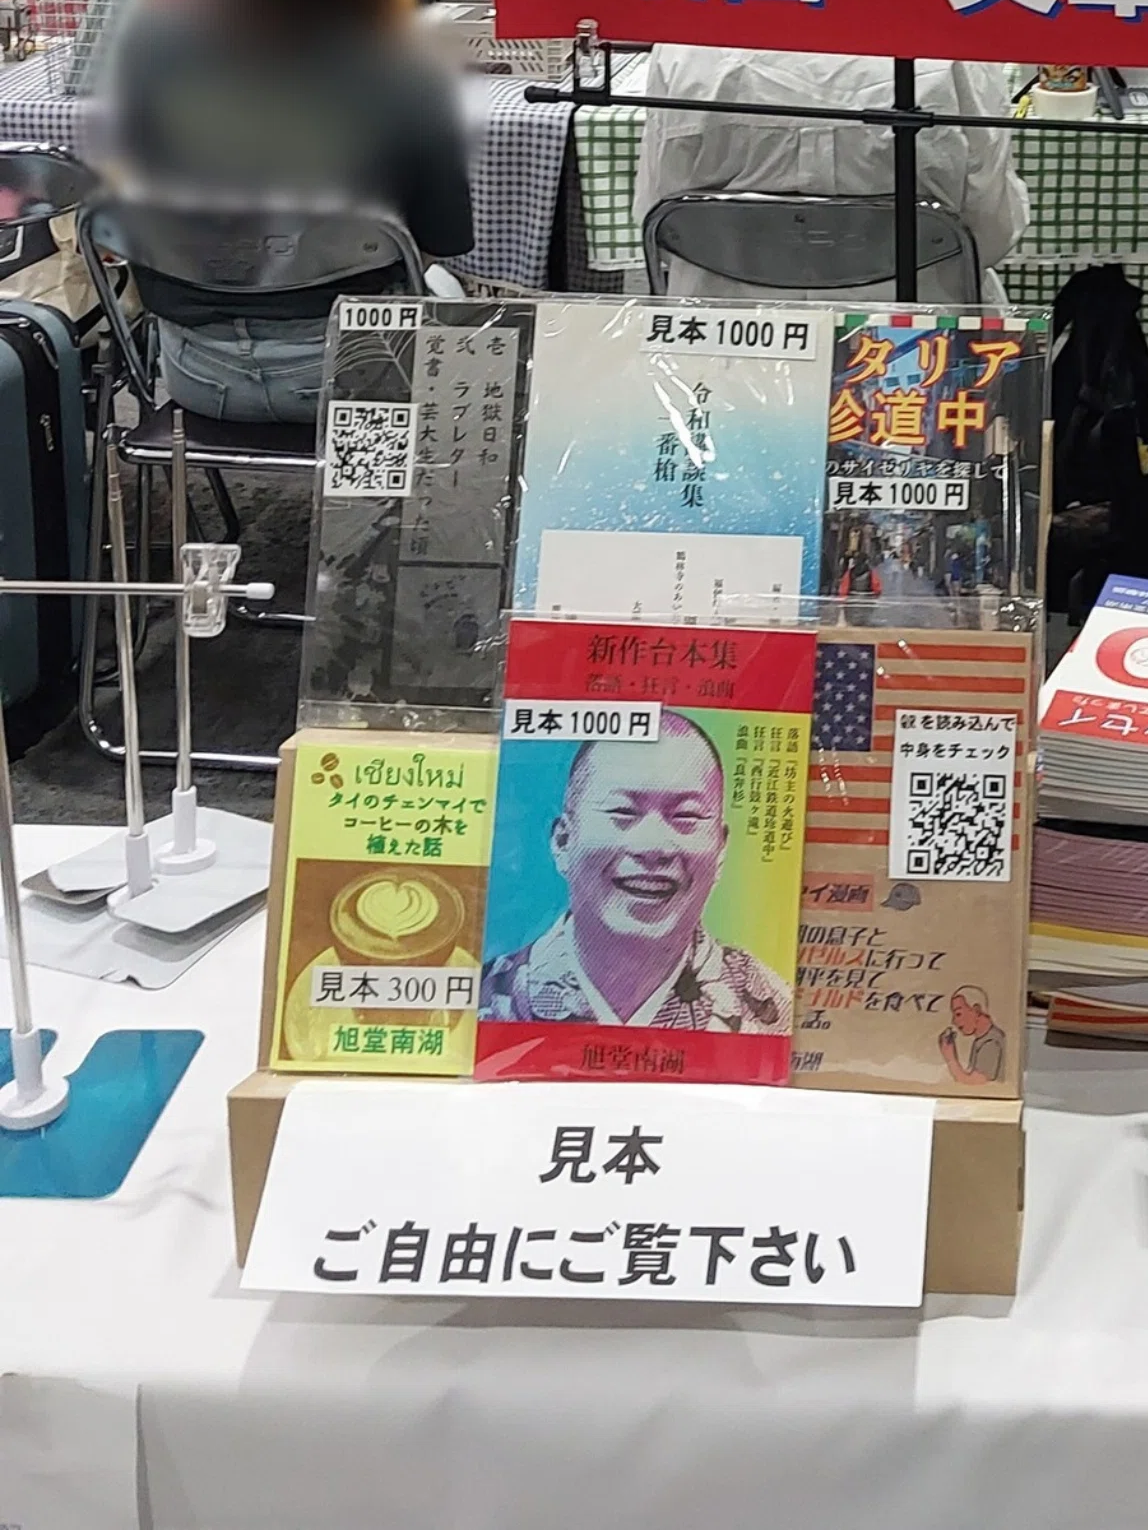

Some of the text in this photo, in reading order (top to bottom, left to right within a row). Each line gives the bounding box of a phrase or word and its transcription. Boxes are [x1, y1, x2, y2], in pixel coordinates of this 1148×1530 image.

[344, 305, 419, 328] 1000 円
[486, 336, 506, 356] 壱
[646, 315, 809, 351] 見本 1000 円
[847, 335, 1022, 389] タリア
[450, 380, 472, 488] ラブレター
[834, 481, 964, 506] 見本 1000 円
[587, 634, 738, 671] 新作台本集
[510, 709, 651, 737] 見本 1000 円
[900, 742, 1010, 760] 中身をチェック
[355, 754, 465, 789] เชียงใหม่
[327, 792, 488, 814] タイのチェンマイで
[344, 815, 468, 836] コーヒーの木を
[366, 835, 443, 858] 植えた話
[316, 971, 474, 1005] 見本 300 円
[333, 1026, 444, 1056] 旭堂南湖
[539, 1125, 663, 1185] 見本
[313, 1219, 857, 1287] ご自由にご覧下さい
